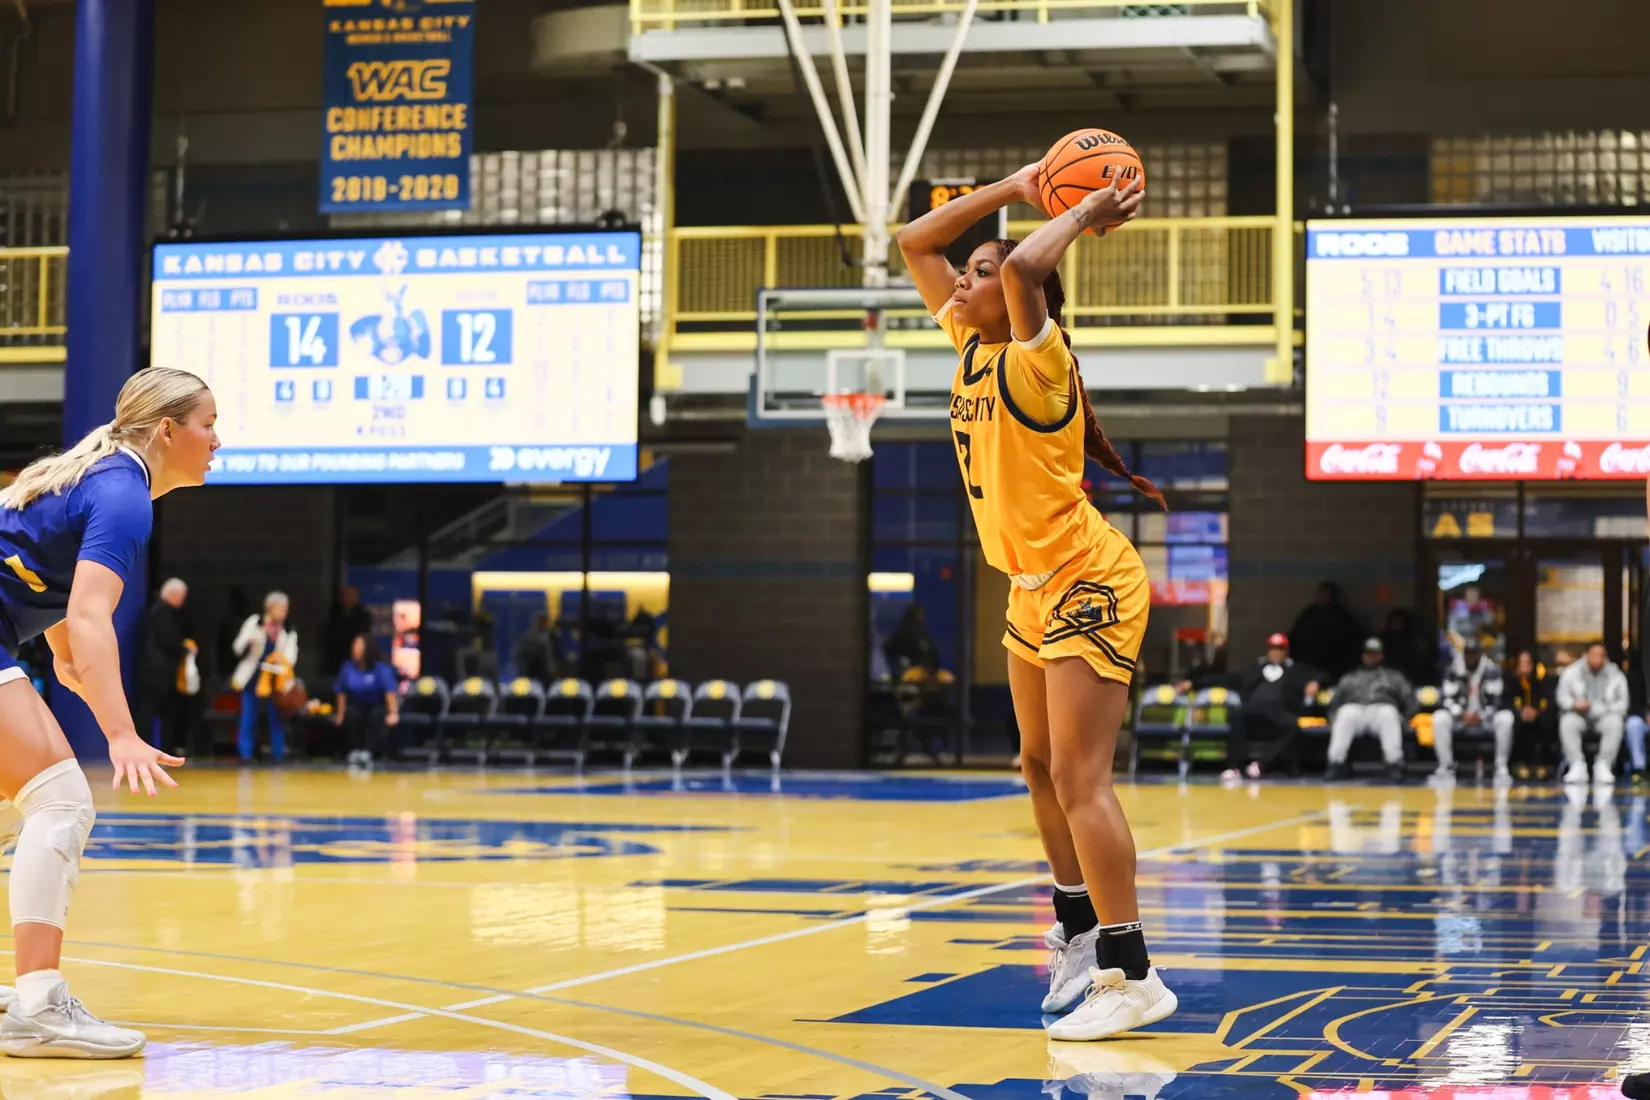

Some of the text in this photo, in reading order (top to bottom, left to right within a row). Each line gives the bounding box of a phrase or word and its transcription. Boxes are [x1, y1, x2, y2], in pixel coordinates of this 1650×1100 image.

[347, 59, 451, 101] WAC
[326, 103, 467, 133] CONFERENCE
[330, 132, 461, 161] CHAMPIONS
[1316, 232, 1409, 256] ROOS
[1435, 229, 1567, 254] GAME STATS
[163, 250, 366, 275] KANSAS CITY
[415, 245, 627, 268] BASKETBALL
[1446, 267, 1555, 293] FIELD GOALS
[1465, 303, 1510, 328] 3-PT
[285, 316, 327, 365] 14
[456, 312, 496, 363] 12
[1442, 336, 1563, 362] FREE THROWS
[1448, 405, 1553, 430] TURNOVERS
[225, 454, 256, 472] YOU
[257, 454, 278, 472] TO
[516, 446, 612, 477] evergy
